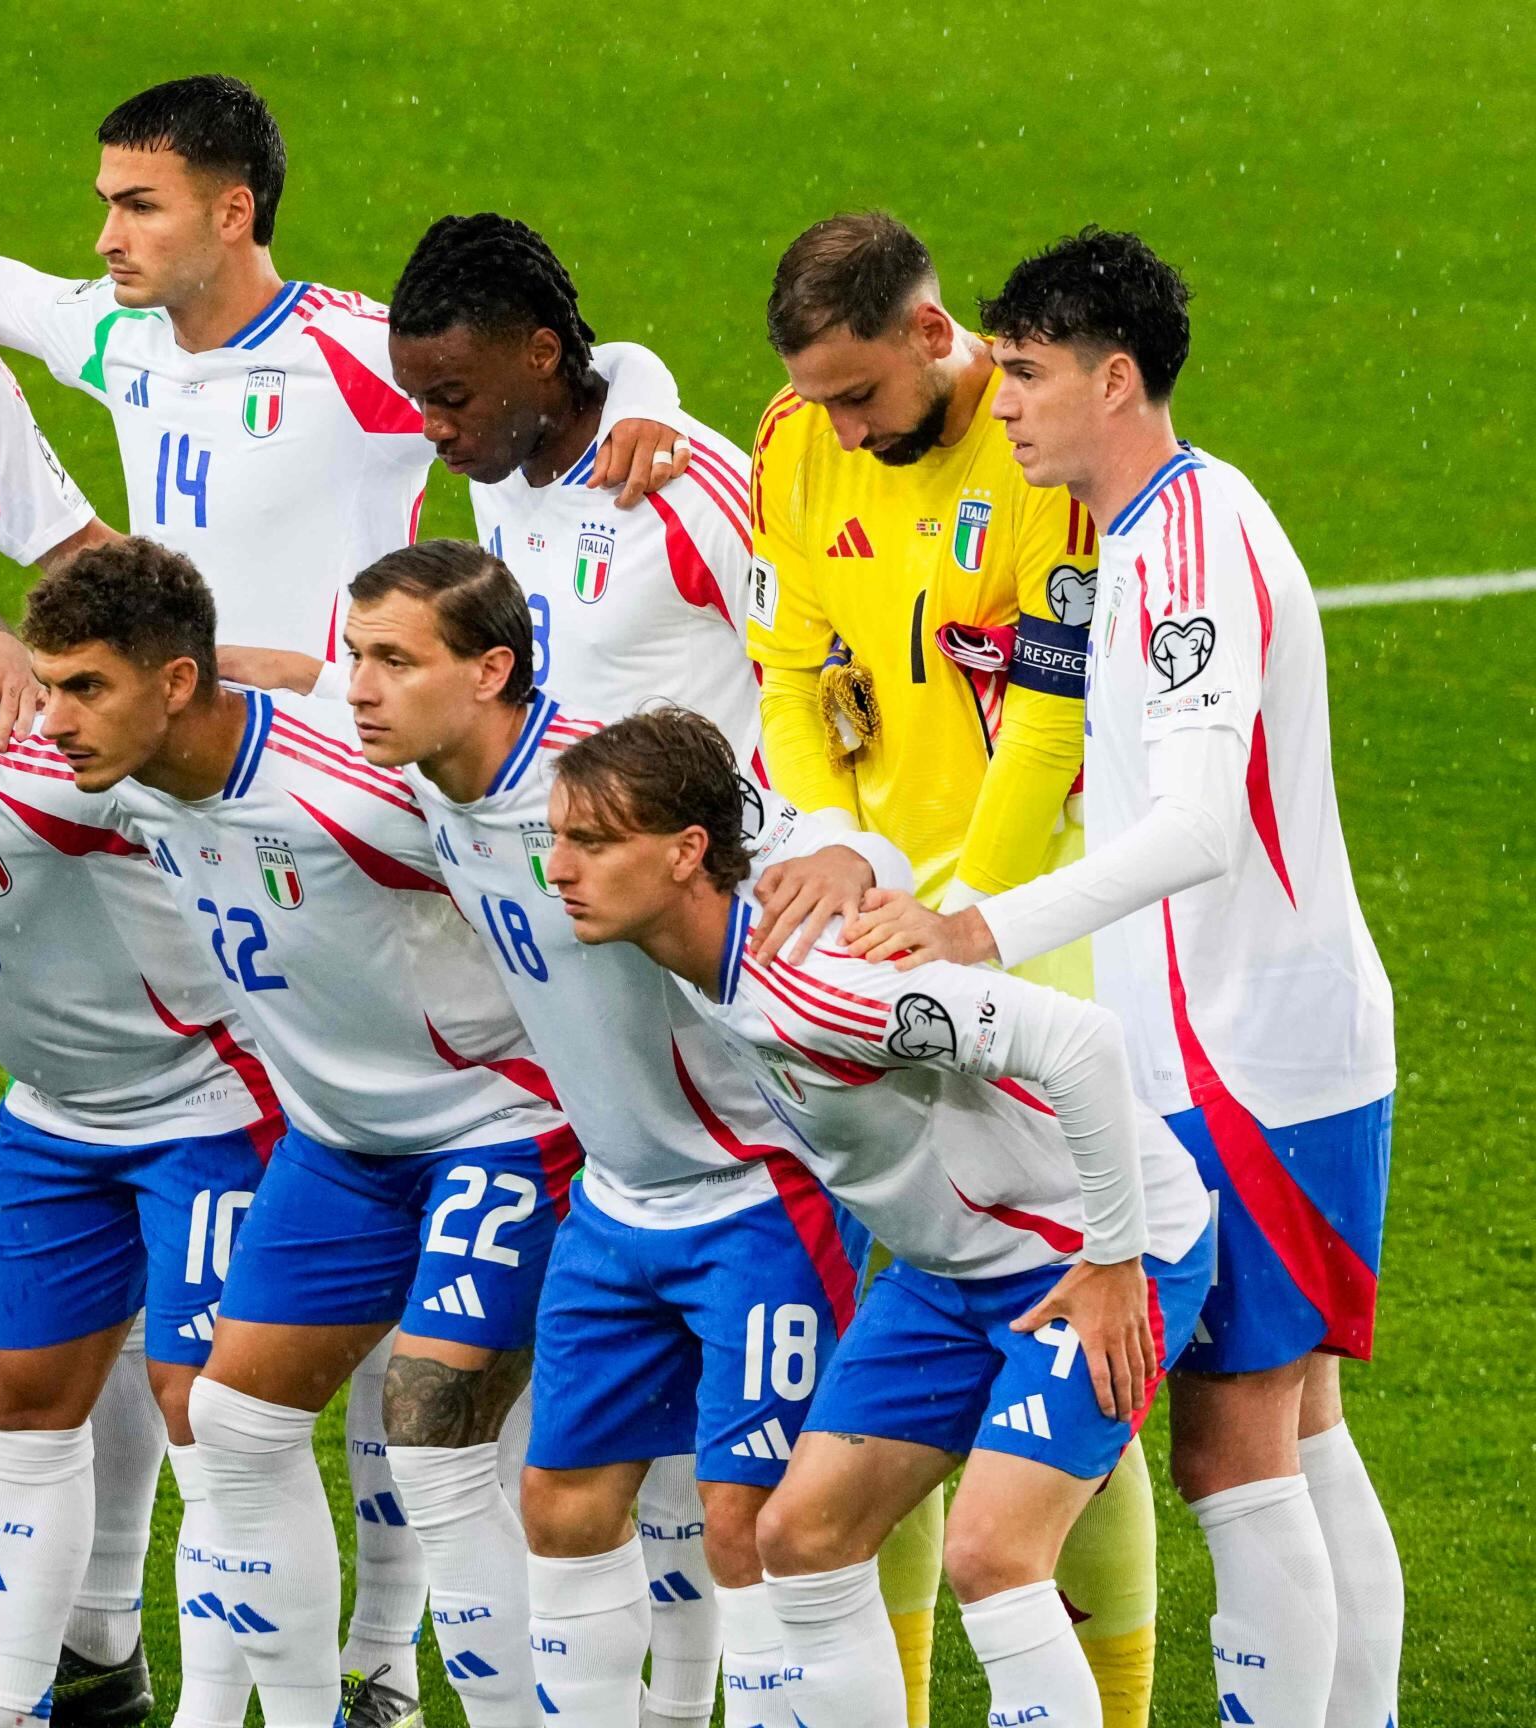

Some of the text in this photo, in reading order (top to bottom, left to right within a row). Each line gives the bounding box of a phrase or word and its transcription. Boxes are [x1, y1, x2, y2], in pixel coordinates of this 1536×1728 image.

[249, 376, 281, 388] ITALIA
[156, 432, 211, 528] 14
[961, 503, 992, 522] ITALIA
[580, 538, 610, 556] ITALIA
[910, 589, 927, 684] 1
[261, 851, 293, 865] ITALIA
[197, 897, 289, 993] 22
[481, 894, 549, 983] 18
[426, 1165, 537, 1267] 22
[744, 1303, 817, 1401] 18
